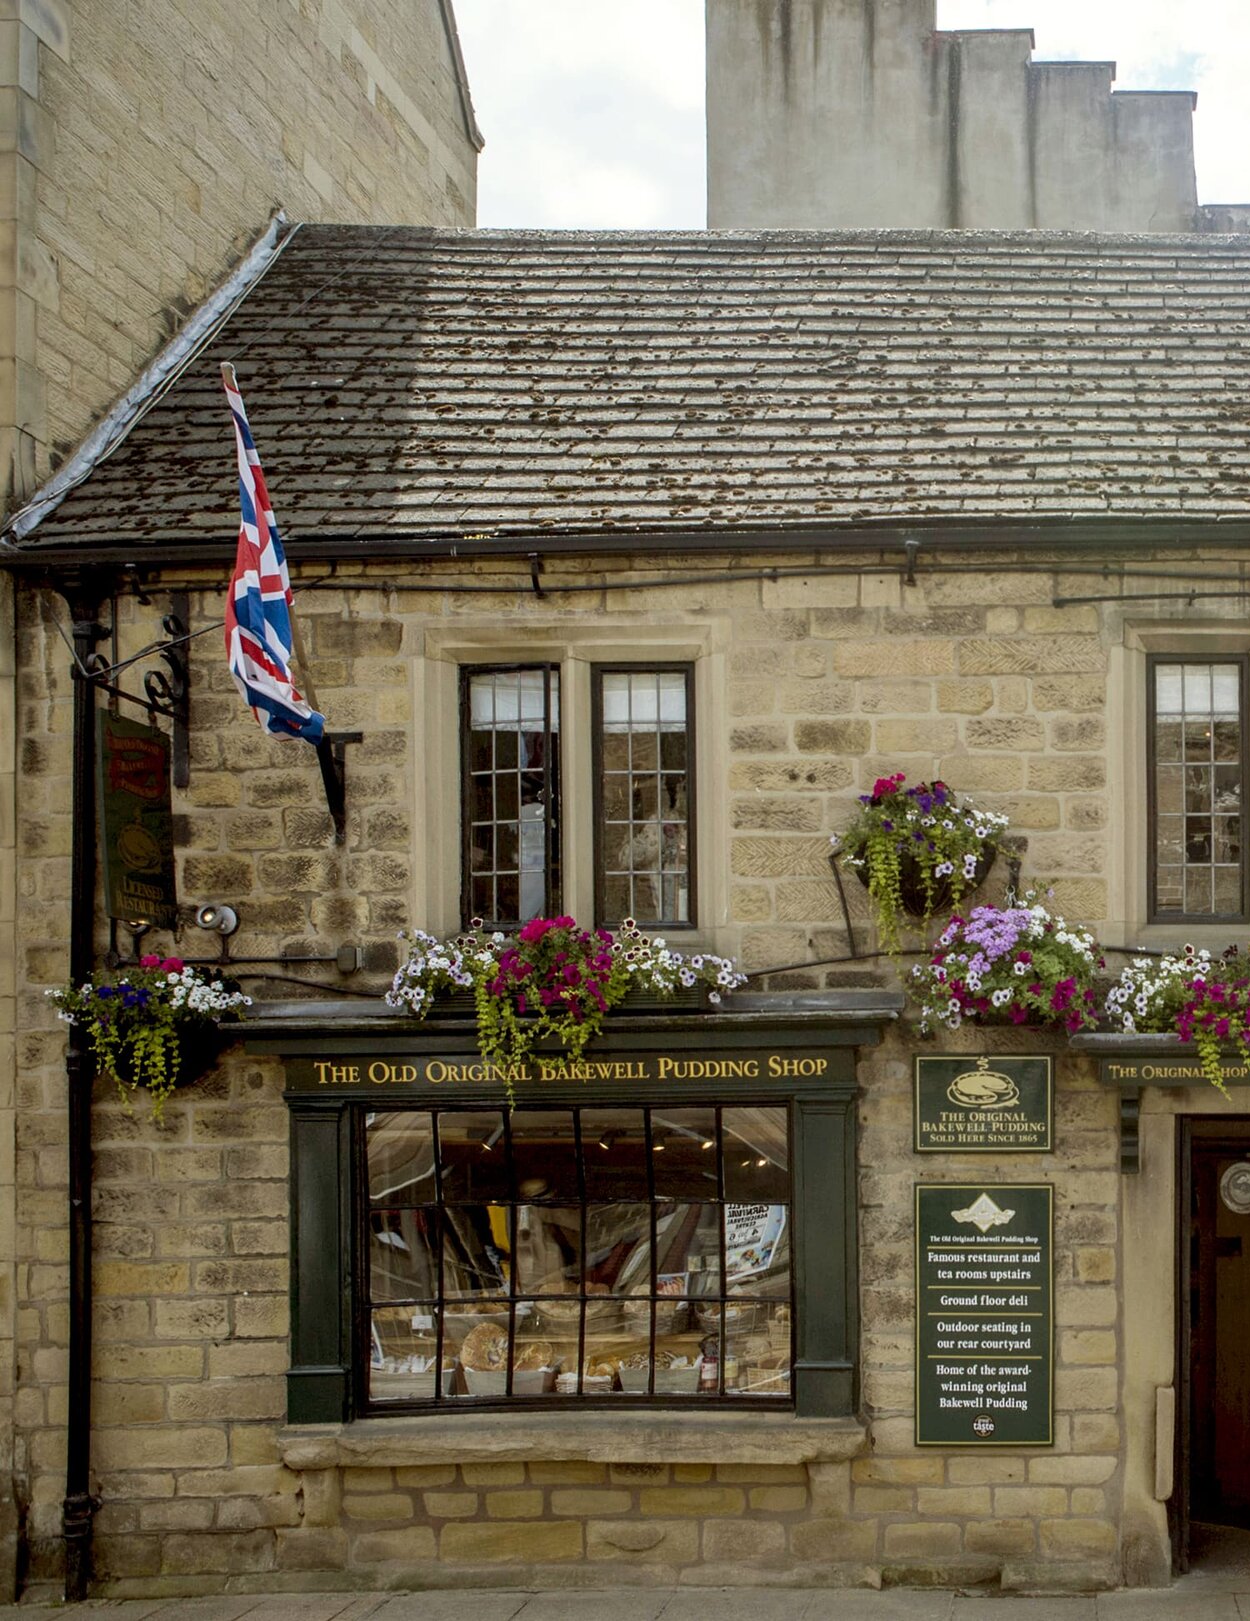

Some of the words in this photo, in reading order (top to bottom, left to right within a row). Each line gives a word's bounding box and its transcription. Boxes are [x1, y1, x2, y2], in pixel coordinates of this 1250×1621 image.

[313, 1061, 360, 1084] THE
[368, 1061, 417, 1083] OLD
[657, 1057, 759, 1079] PUDDING
[768, 1055, 828, 1077] SHOP
[1108, 1065, 1137, 1079] THE
[1214, 1065, 1248, 1079] HOP
[952, 1235, 975, 1243] Original
[1025, 1236, 1039, 1244] Shop
[927, 1252, 965, 1263] Famous
[967, 1253, 1019, 1263] restaurant
[1021, 1252, 1040, 1263] and
[937, 1269, 953, 1279] tea
[955, 1270, 988, 1279] rooms
[990, 1269, 1031, 1282] upstairs
[940, 1295, 978, 1306] Ground
[980, 1295, 1007, 1306] floor
[1008, 1295, 1028, 1306] deli
[937, 1321, 979, 1333] Outdoor
[981, 1322, 1018, 1335] seating
[1020, 1322, 1031, 1333] in
[937, 1340, 955, 1349] our
[957, 1340, 979, 1349] rear
[981, 1338, 1031, 1351] courtyard
[936, 1365, 965, 1375] Home
[966, 1365, 979, 1375] of
[980, 1365, 996, 1375] the
[998, 1365, 1032, 1375] award-
[941, 1381, 984, 1394] winning
[985, 1381, 1027, 1394] original
[939, 1398, 984, 1408] Bakewell
[985, 1398, 1028, 1410] Pudding
